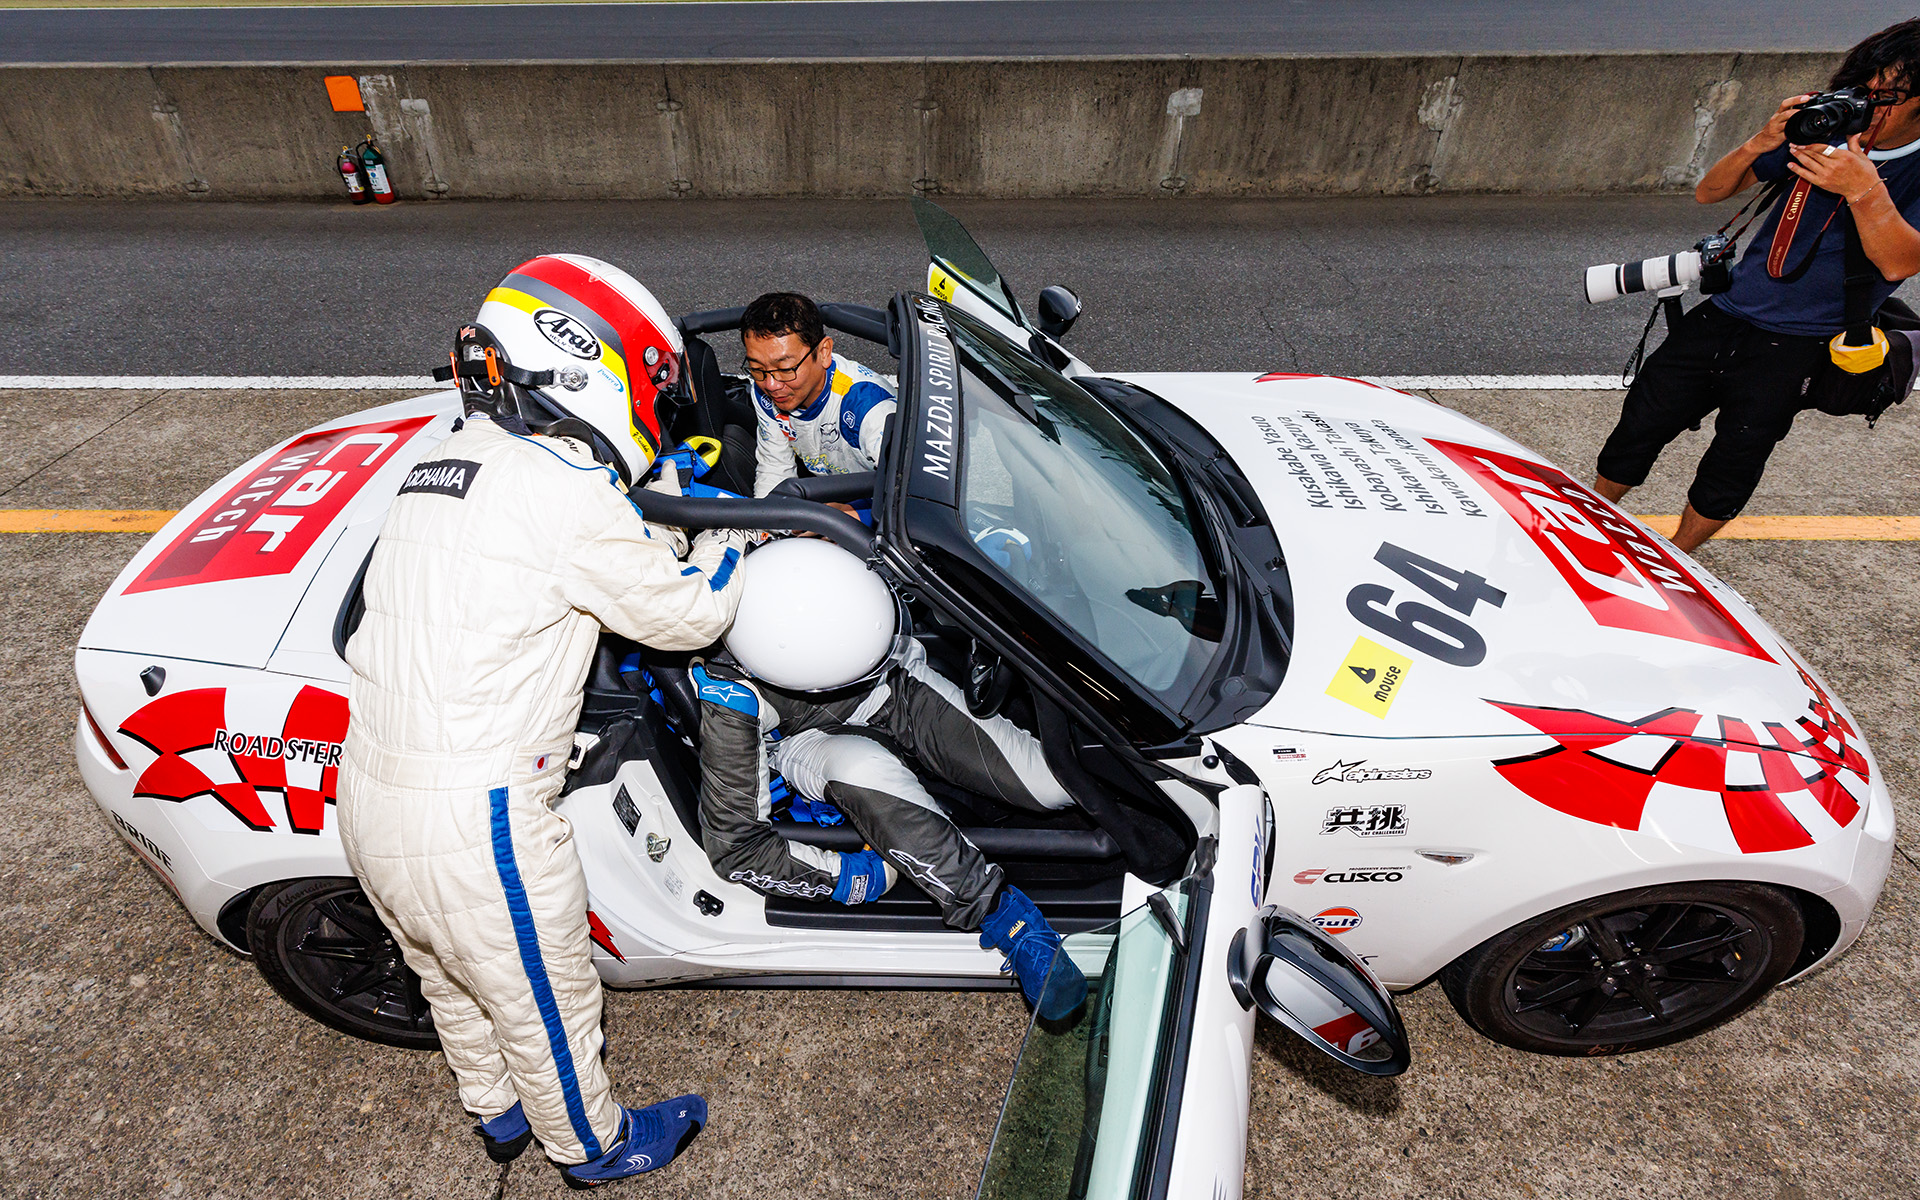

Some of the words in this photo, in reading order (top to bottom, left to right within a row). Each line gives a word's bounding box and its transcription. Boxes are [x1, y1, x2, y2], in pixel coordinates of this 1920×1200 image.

[1786, 191, 1804, 220] Canon
[536, 317, 598, 354] Arai
[922, 298, 947, 340] RACING
[928, 340, 953, 392] SPIRIT
[922, 396, 953, 480] MAZDA
[1251, 415, 1281, 446] Yasuo
[1277, 416, 1317, 452] Kazuya
[1297, 410, 1342, 446] Takashi
[1344, 421, 1382, 455] Takuya
[1371, 419, 1414, 455] Kanata
[1278, 447, 1333, 509] Kusakabe
[1311, 452, 1366, 510] Ishikawa
[1339, 444, 1407, 512] Kobayashi
[1385, 457, 1448, 515] Ishikawa
[1419, 455, 1488, 518] Kawakami
[1345, 541, 1508, 667] 64
[1373, 664, 1401, 703] mouse
[213, 729, 343, 767] ROADSTER
[1346, 768, 1432, 783] alpinestars
[1325, 806, 1405, 832] 共挑
[109, 810, 173, 873] BRIDE
[1323, 872, 1403, 883] CUSCO
[1311, 917, 1360, 927] Gulf
